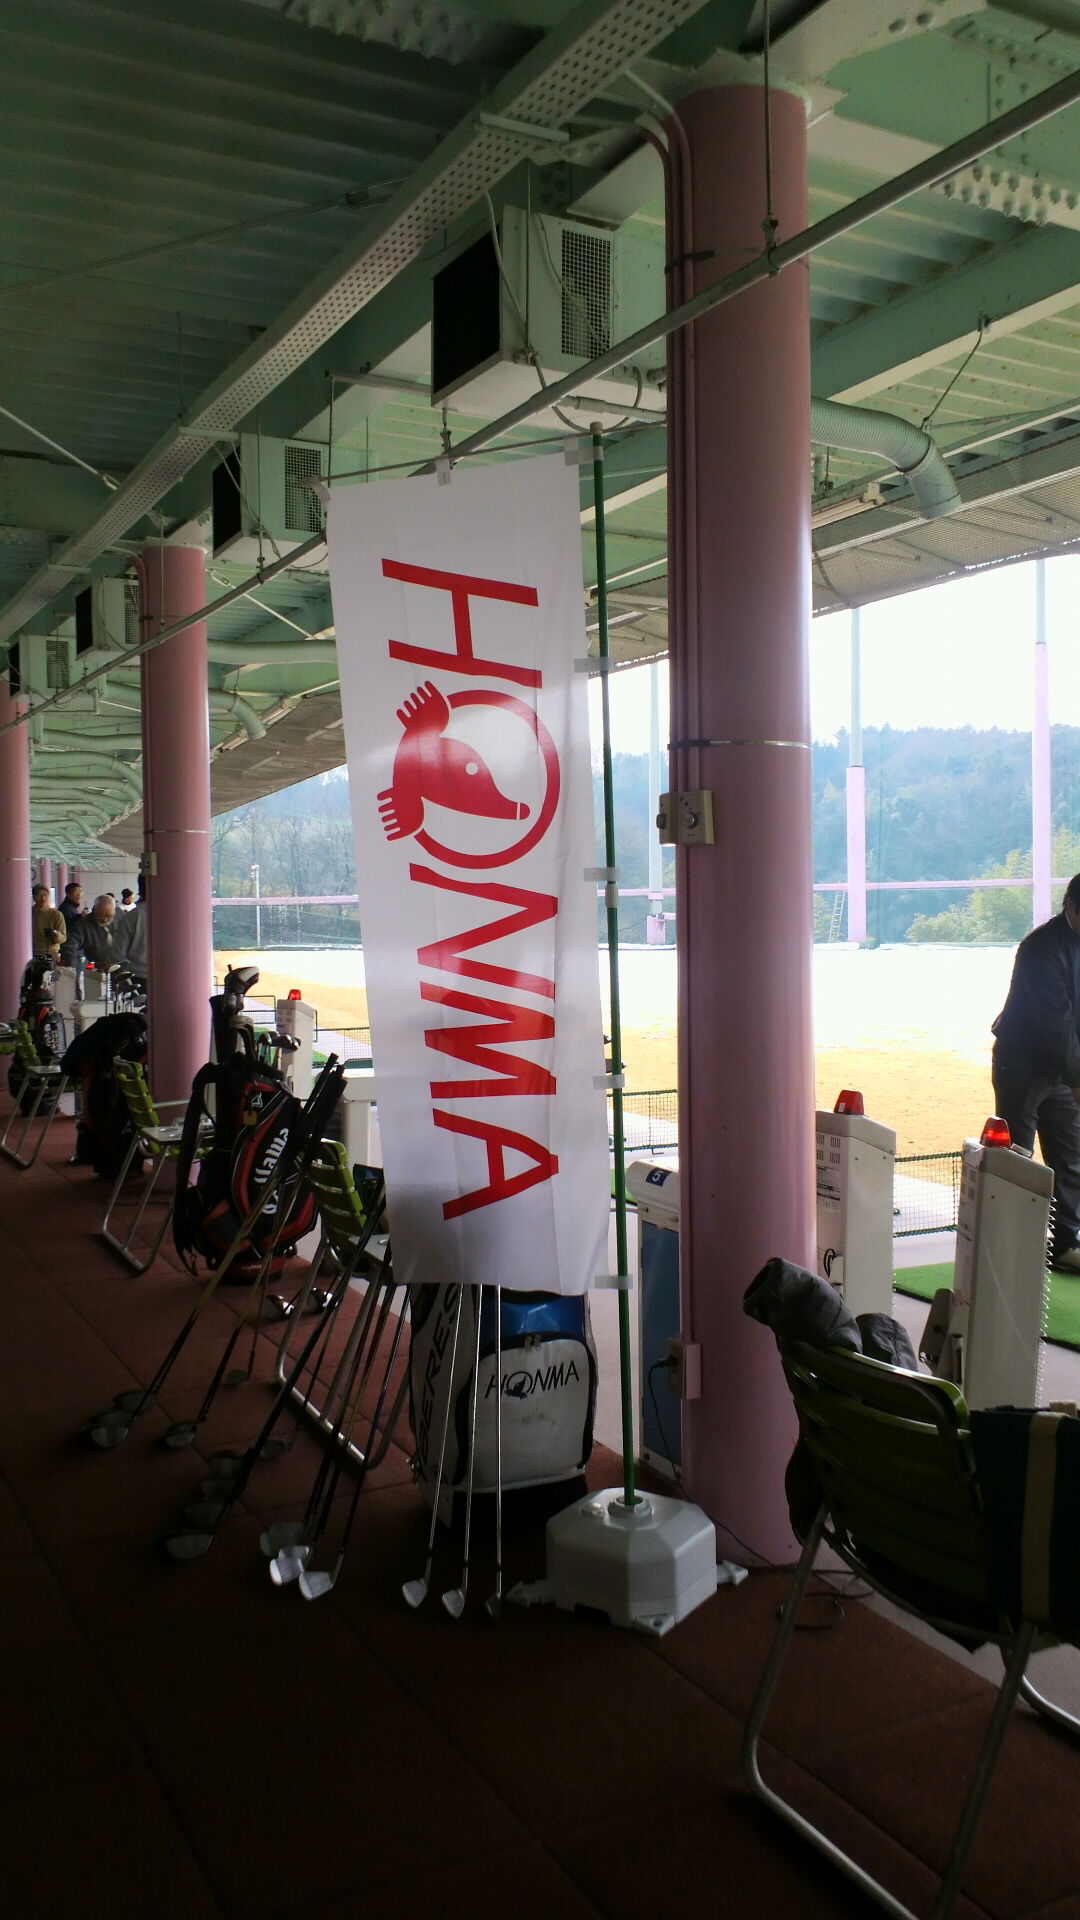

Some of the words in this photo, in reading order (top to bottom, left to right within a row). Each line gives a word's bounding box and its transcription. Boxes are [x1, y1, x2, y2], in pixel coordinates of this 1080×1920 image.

[377, 557, 560, 1220] HONMA
[651, 1170, 664, 1182] 5
[484, 1360, 580, 1399] HONMA
